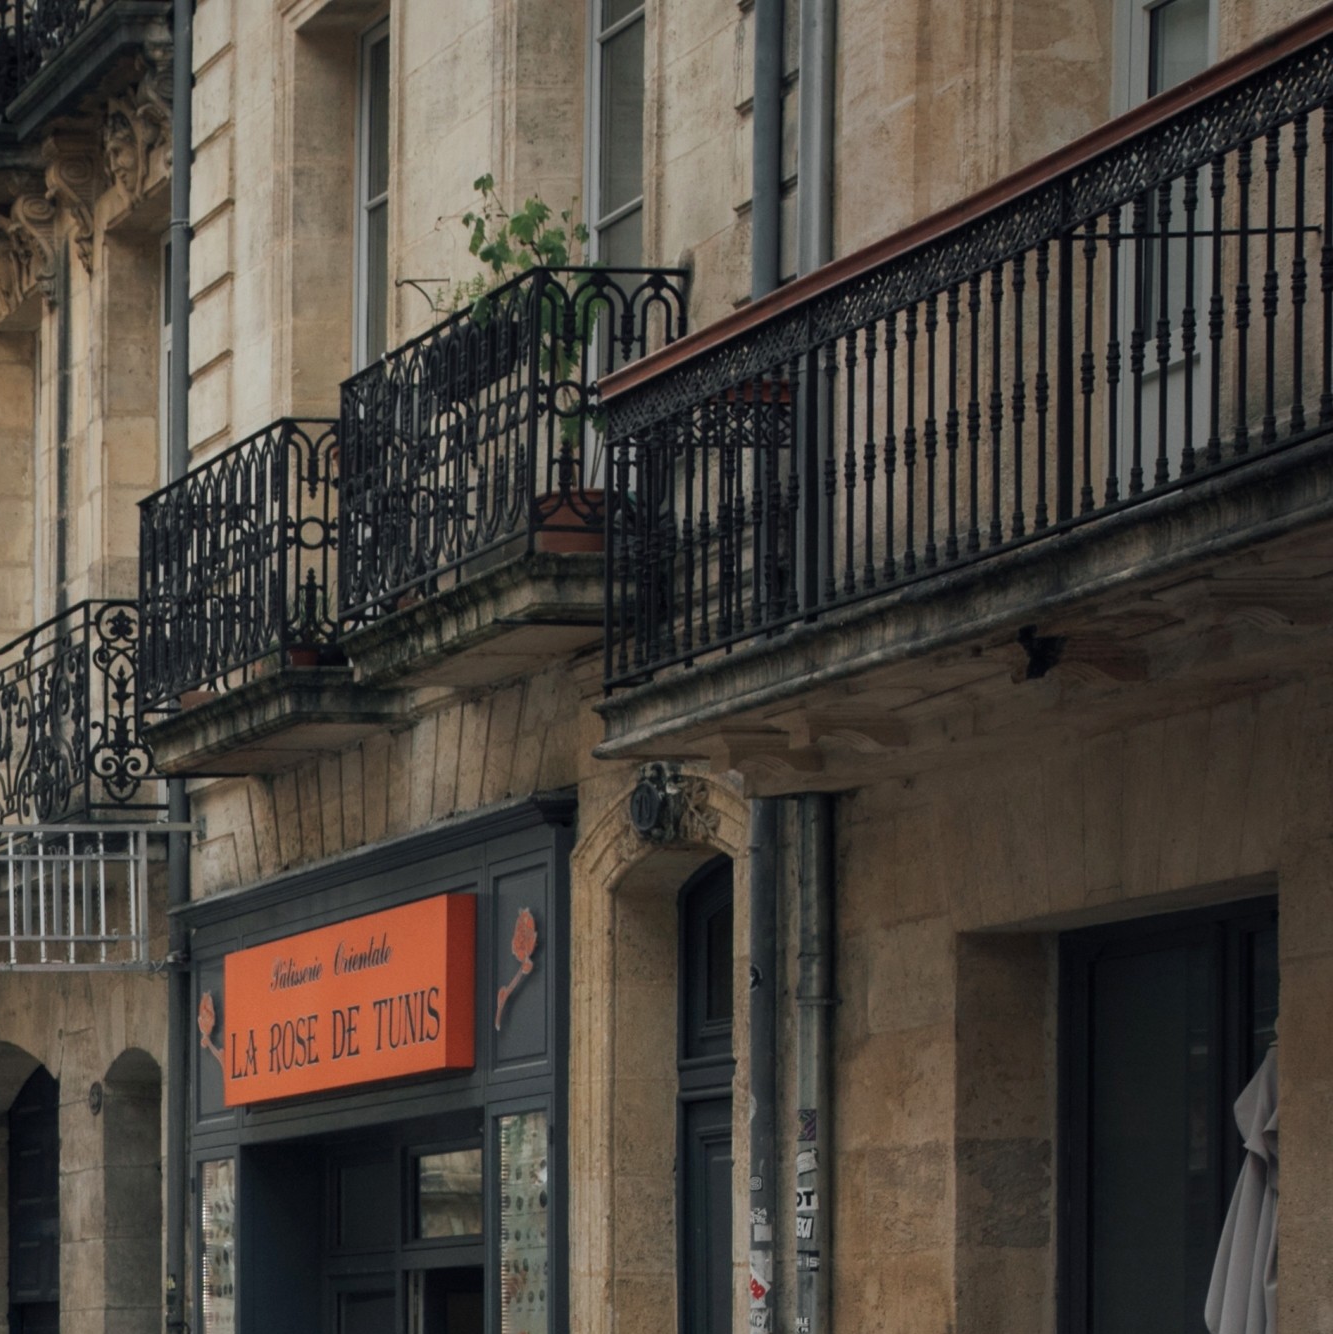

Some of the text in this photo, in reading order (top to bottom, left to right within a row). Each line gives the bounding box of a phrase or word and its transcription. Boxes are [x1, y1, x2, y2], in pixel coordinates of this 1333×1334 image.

[334, 932, 392, 976] Orientale
[230, 986, 441, 1080] LA ROSE DE TUNIS
